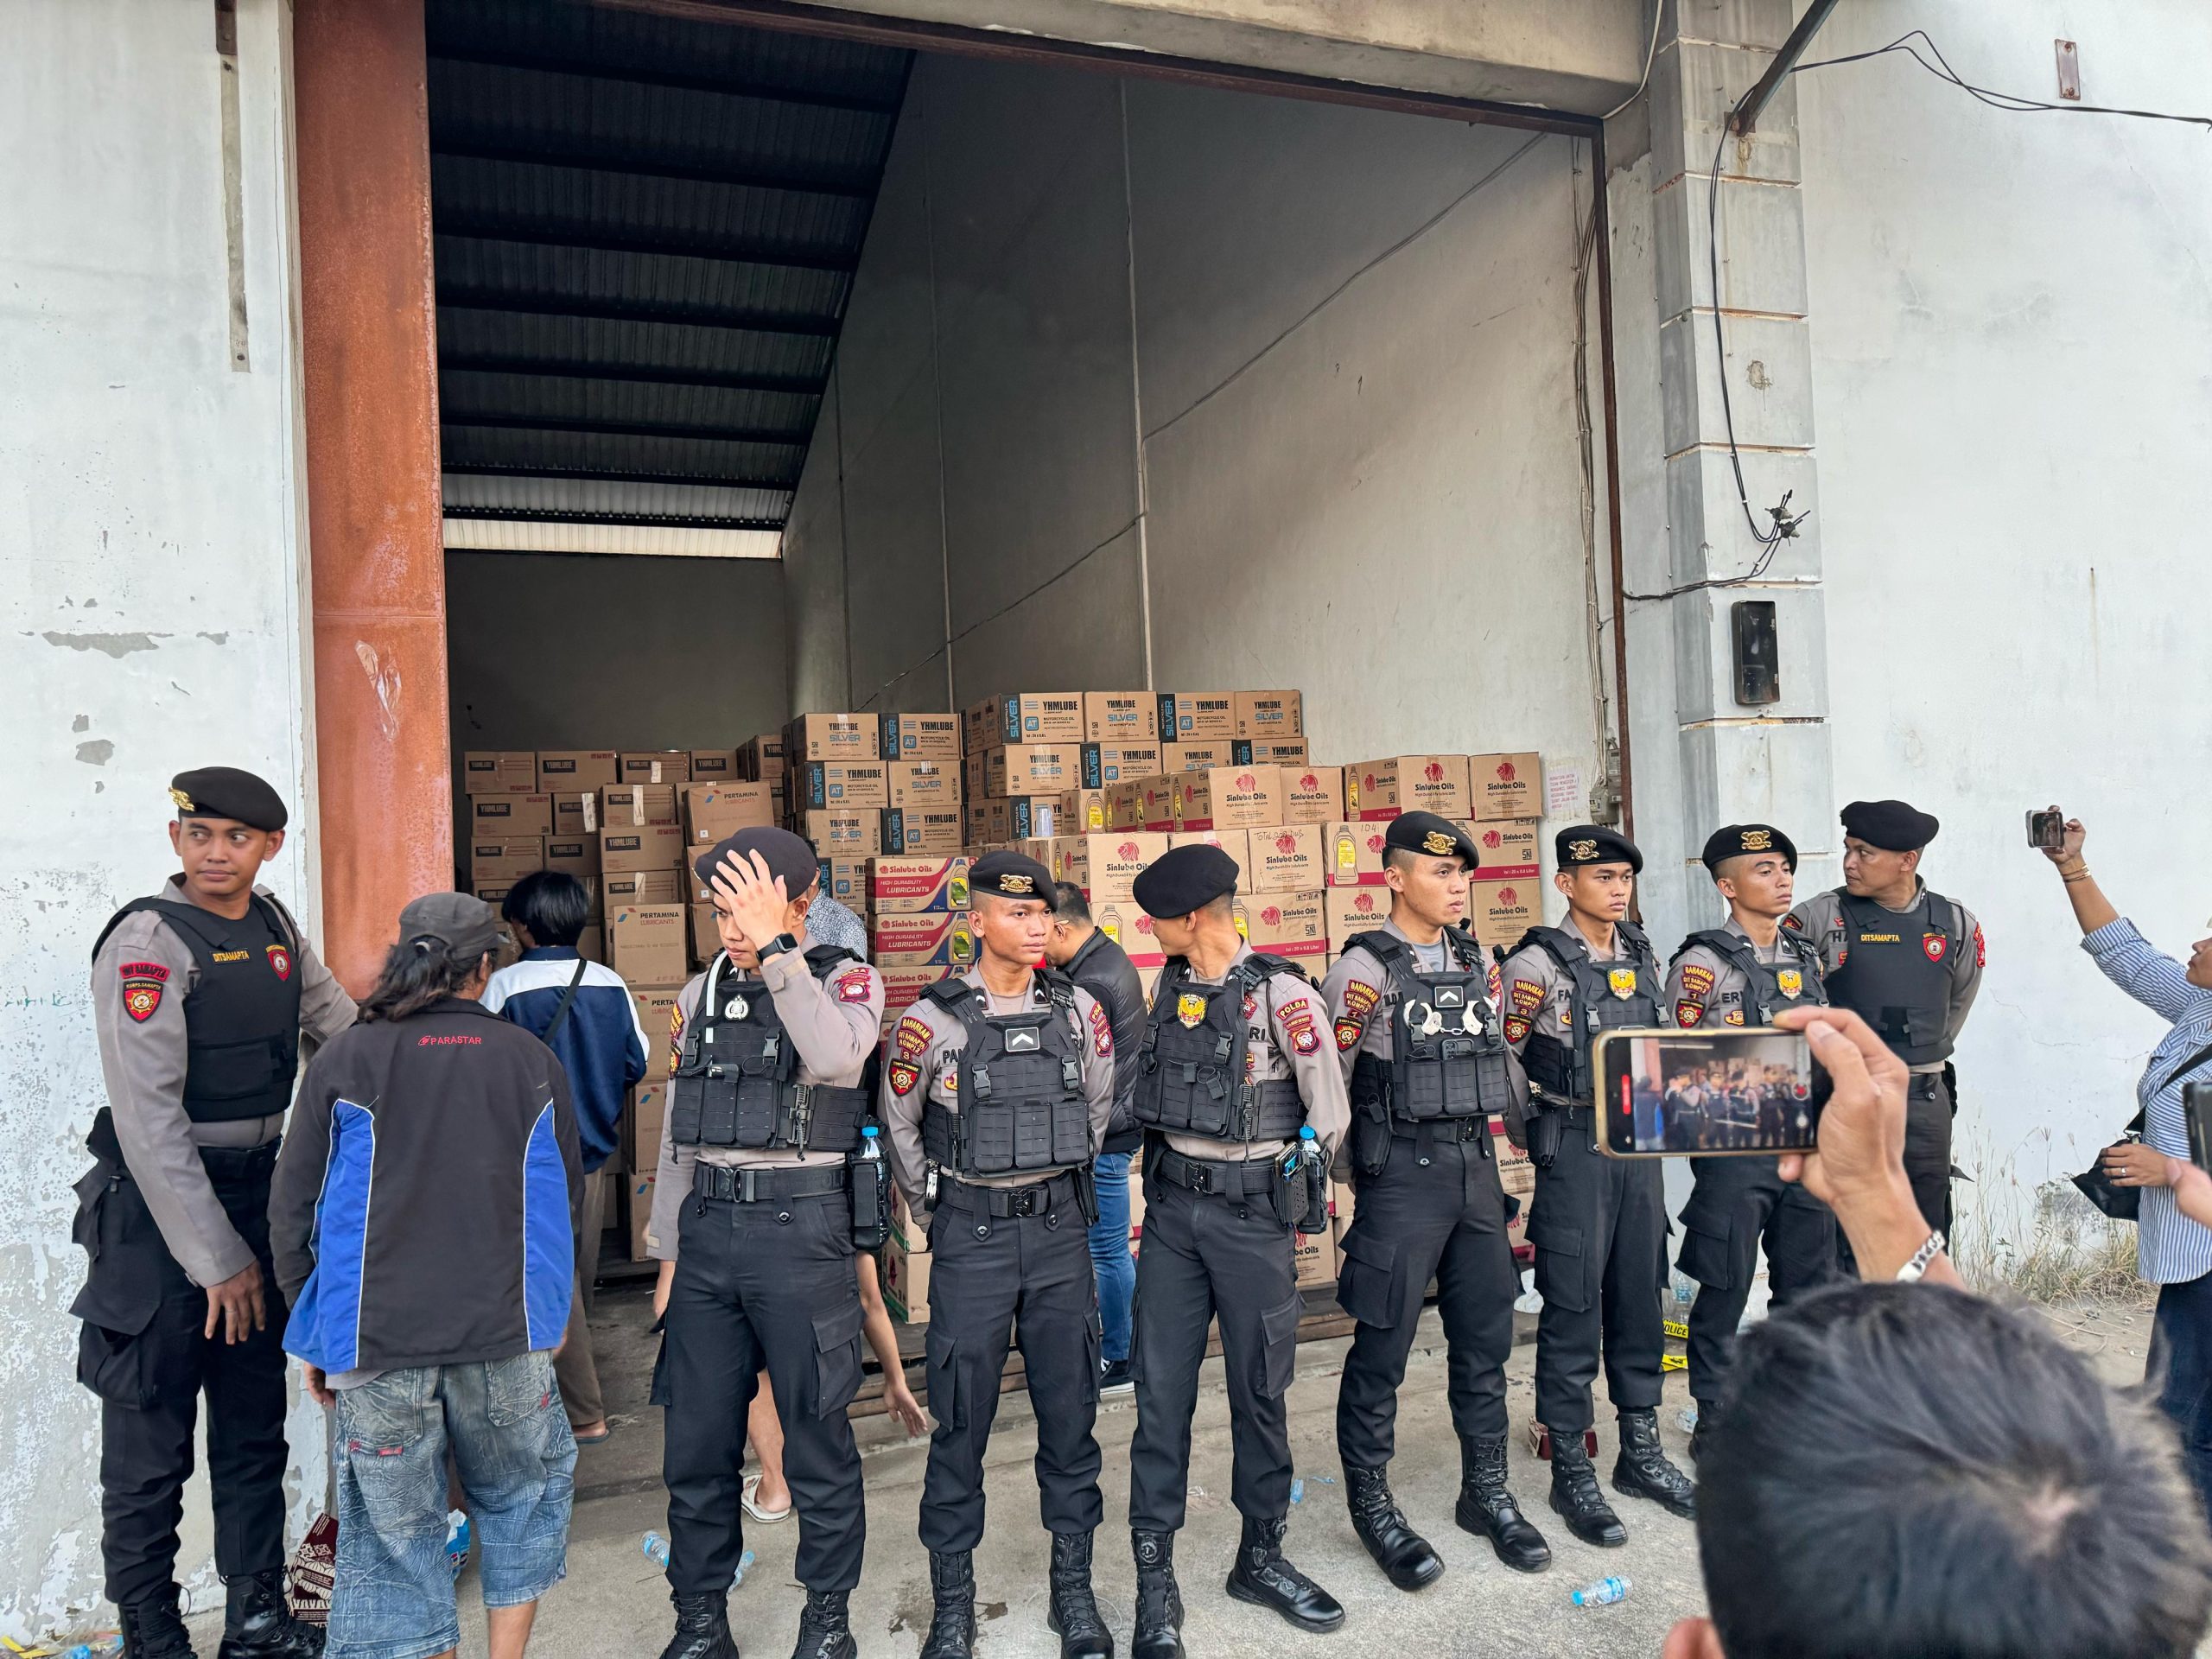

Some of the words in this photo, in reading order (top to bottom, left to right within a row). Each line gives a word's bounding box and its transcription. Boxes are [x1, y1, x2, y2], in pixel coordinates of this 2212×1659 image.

[1043, 701, 1077, 710] YHMLUBE
[1107, 700, 1135, 709] YHMLUBE
[1196, 701, 1229, 710] YHMLUBE
[1009, 700, 1019, 738] SILVER
[1107, 714, 1138, 722] SILVER
[1165, 700, 1174, 737] SILVER
[920, 721, 954, 731] YHMLUBE
[888, 719, 897, 754] SILVER
[1122, 750, 1156, 760] YHMLUBE
[1185, 751, 1212, 760] YHMLUBE
[1272, 747, 1304, 756] YHMLUBE
[1090, 749, 1099, 786] SILVER
[847, 769, 881, 779] YHMLUBE
[813, 767, 823, 804] SILVER
[925, 814, 957, 823] YHMLUBE
[892, 814, 901, 849] SILVER
[609, 838, 638, 847] YHMLUBE
[1522, 849, 1532, 860] SNI
[1305, 925, 1316, 936] SNI
[1860, 933, 1900, 943] DITSAMAPTA
[213, 950, 249, 962] DITSAMAPTA
[1280, 1001, 1306, 1018] POLDA
[1249, 1027, 1266, 1041] RI
[430, 1036, 482, 1046] PARASTAR
[1664, 1325, 1688, 1336] OLICE
